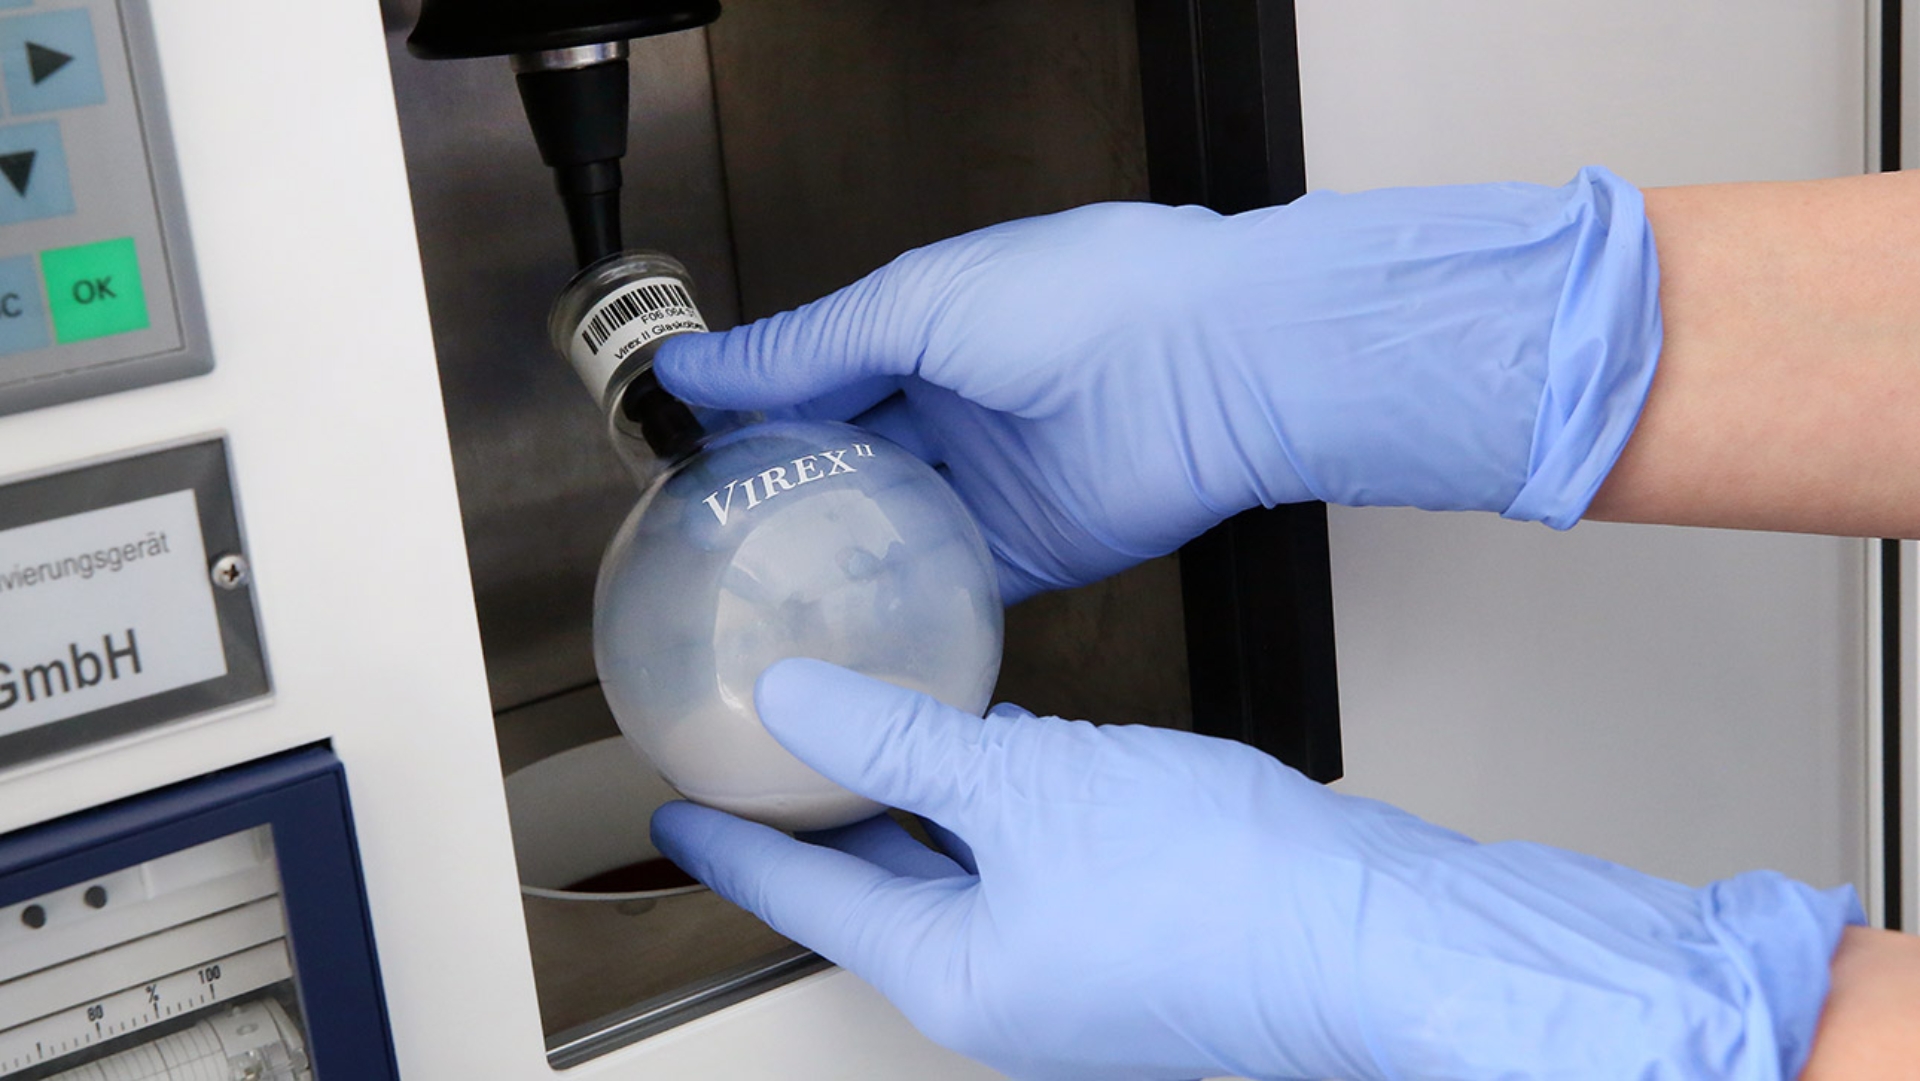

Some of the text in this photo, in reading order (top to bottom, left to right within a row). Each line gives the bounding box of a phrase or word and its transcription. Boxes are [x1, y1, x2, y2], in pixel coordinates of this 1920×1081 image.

[0, 292, 23, 318] C
[72, 275, 117, 305] OK
[614, 338, 642, 360] Virex
[702, 449, 858, 527] VIREX
[0, 531, 170, 592] vierungsgerät
[0, 628, 142, 711] GmbH
[87, 1004, 104, 1021] 80
[198, 964, 221, 984] 100
